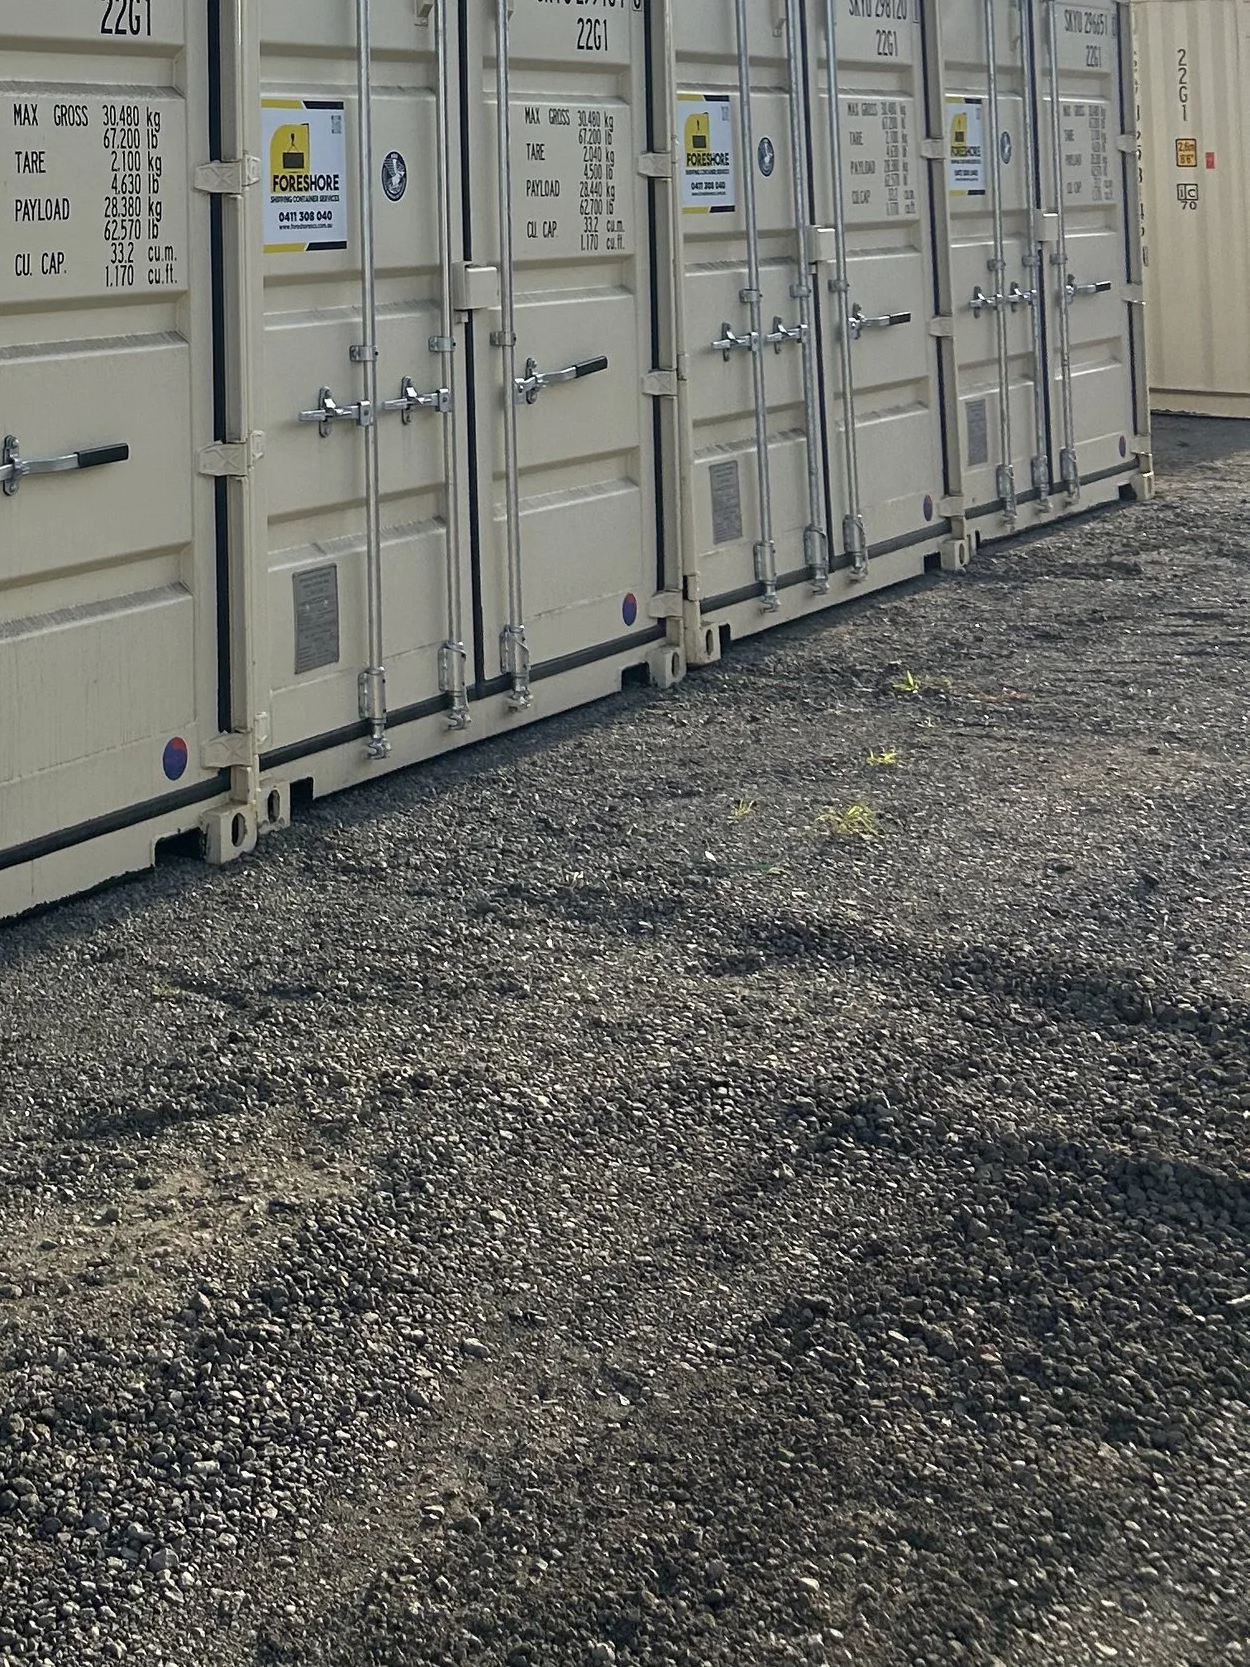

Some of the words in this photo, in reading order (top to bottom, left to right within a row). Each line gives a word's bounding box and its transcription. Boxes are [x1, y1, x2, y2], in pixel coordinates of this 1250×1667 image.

[577, 18, 608, 51] 22G1
[14, 104, 38, 126] MAX
[54, 104, 88, 126] GROSS
[147, 107, 160, 132] kg
[525, 108, 540, 124] MAX
[549, 108, 570, 125] GROSS
[604, 110, 614, 132] kg
[147, 128, 158, 149] lb
[605, 130, 612, 145] lb
[15, 151, 46, 173] TARE
[148, 151, 161, 176] kg
[526, 144, 545, 160] TARE
[606, 149, 614, 167] kg
[273, 174, 339, 192] FORESHORE
[606, 166, 612, 180] lb
[149, 174, 159, 194] lb
[526, 180, 560, 197] PAYLOAD
[606, 183, 615, 201] kg
[15, 198, 70, 221] PAYLOAD
[148, 197, 162, 222] kg
[607, 200, 614, 214] lb
[1181, 201, 1197, 210] 70
[279, 212, 296, 222] 0411
[299, 211, 314, 221] 308
[317, 211, 332, 221] 040
[584, 217, 598, 232] 33.2
[148, 219, 158, 239] lb
[15, 253, 32, 276] CU.
[42, 252, 67, 274] CAP.
[111, 242, 134, 263] 33.2
[148, 245, 177, 262] cu.m.
[148, 263, 177, 284] cu.ft.
